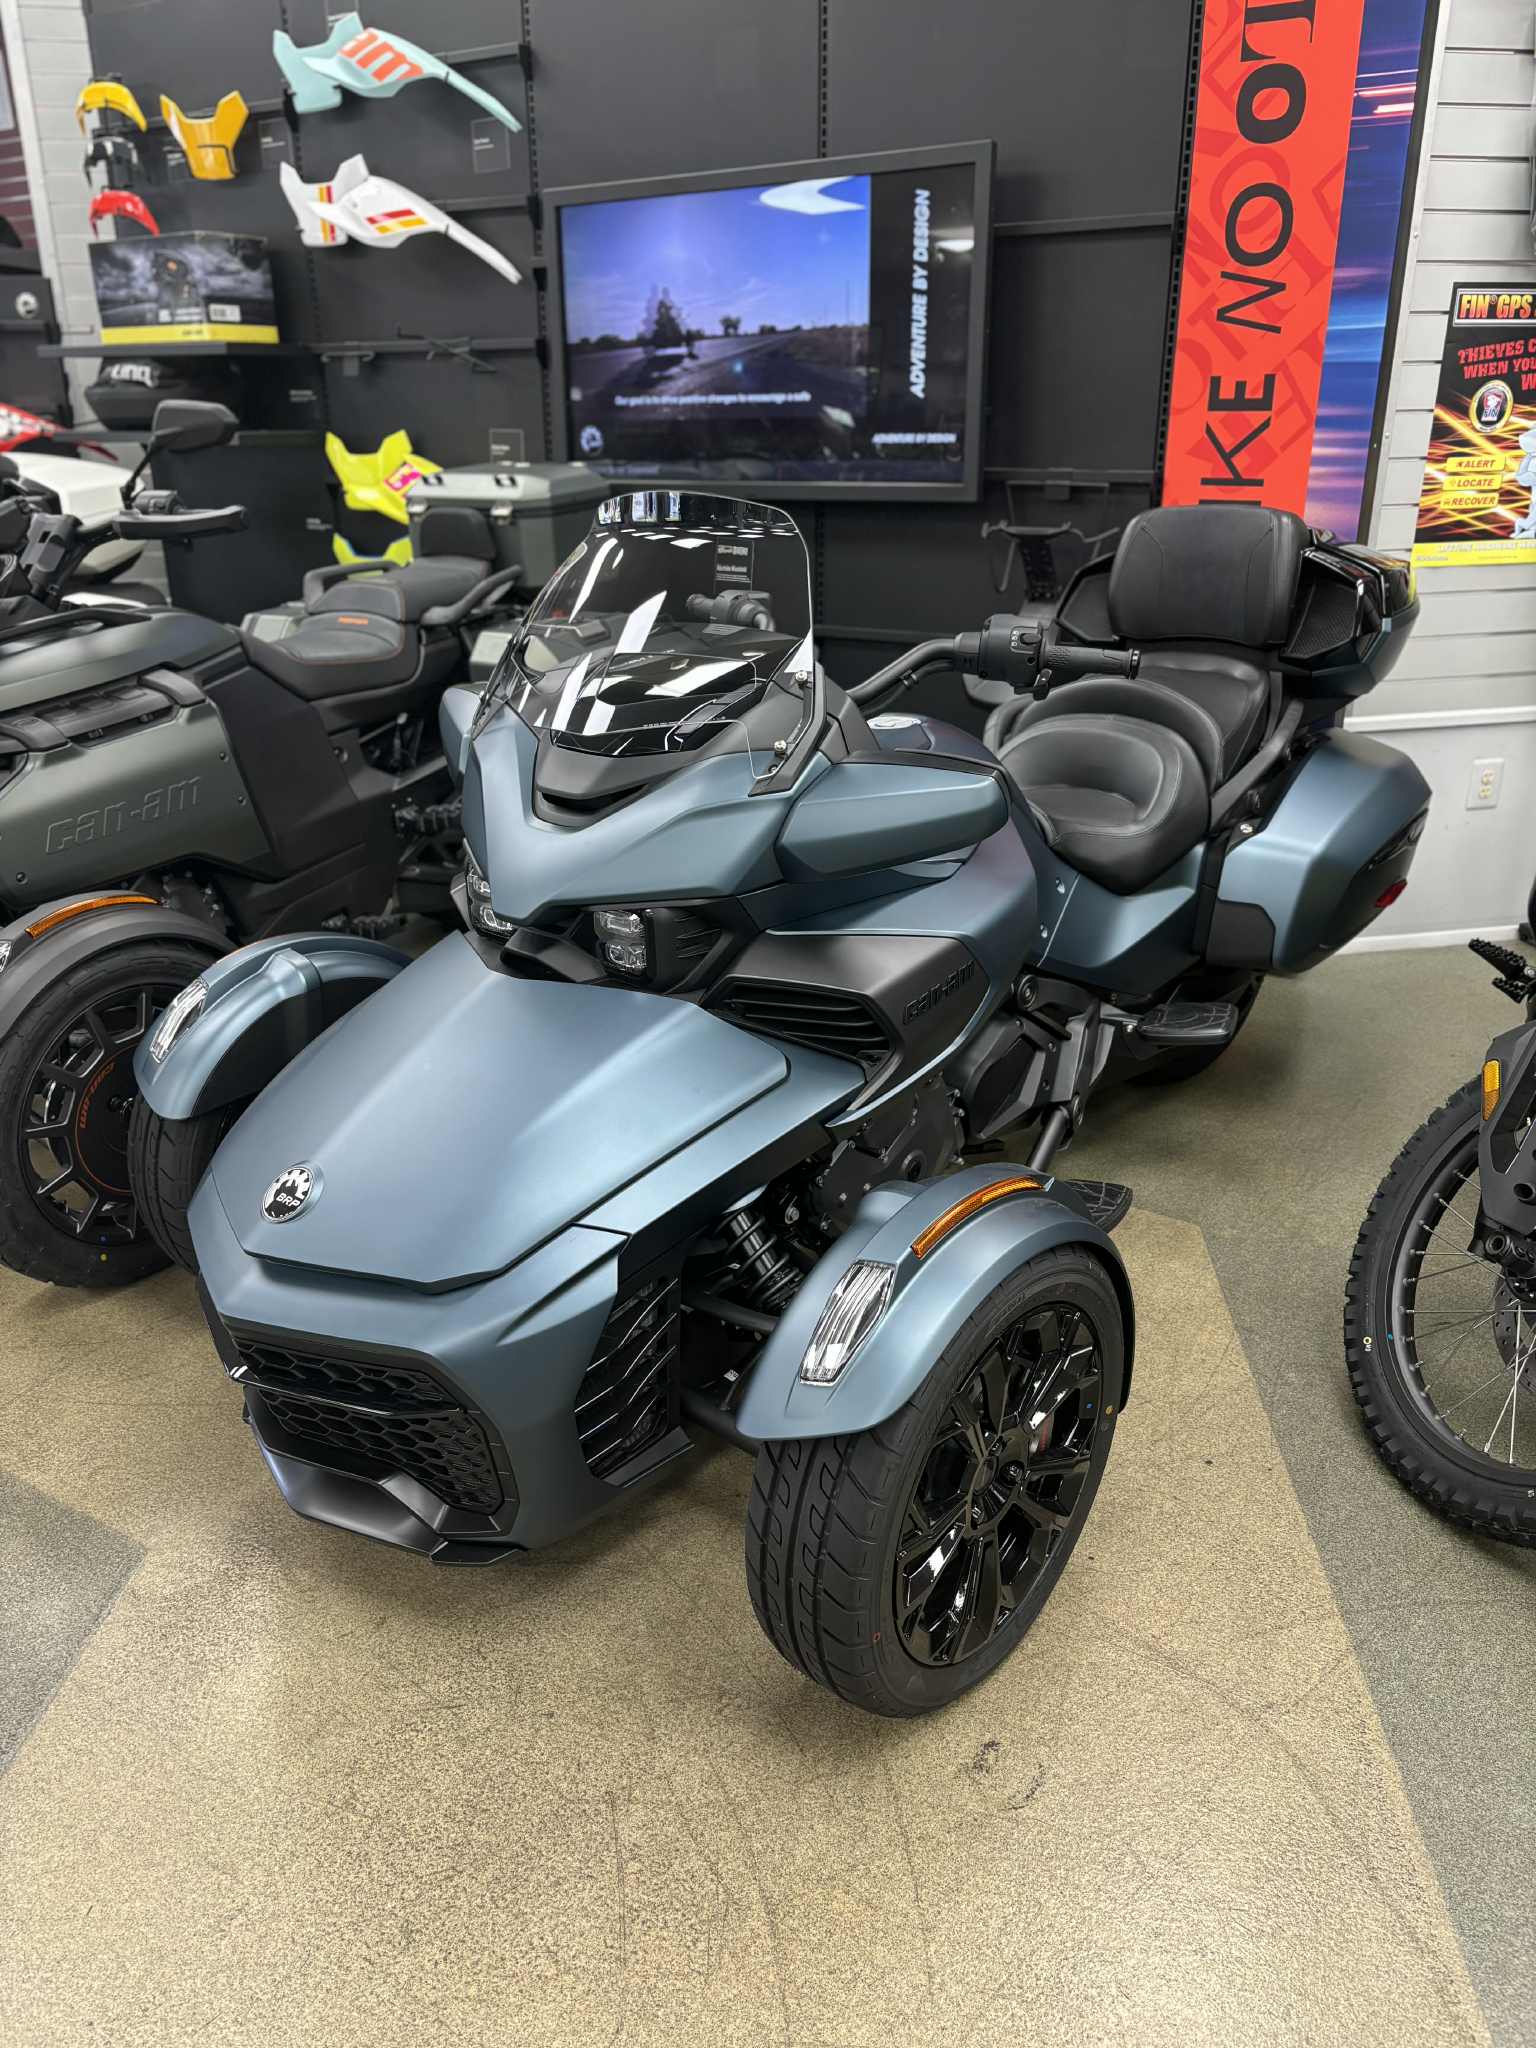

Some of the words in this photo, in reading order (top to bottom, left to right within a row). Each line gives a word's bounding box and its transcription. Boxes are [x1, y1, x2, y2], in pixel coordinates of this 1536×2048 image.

[913, 189, 931, 262] DESIGN
[1217, 182, 1294, 335] NO
[912, 265, 929, 290] BY
[1496, 294, 1533, 318] GPS
[909, 294, 928, 399] ADVENTURE
[1458, 340, 1524, 364] THIEVES
[1463, 361, 1508, 379] WHEN
[1461, 459, 1496, 469] ALERT
[1457, 478, 1494, 488] LOCATE
[1451, 496, 1496, 506] RECOVER
[46, 776, 201, 853] can-am
[902, 959, 975, 1026] can-am
[276, 1192, 301, 1206] BRP
